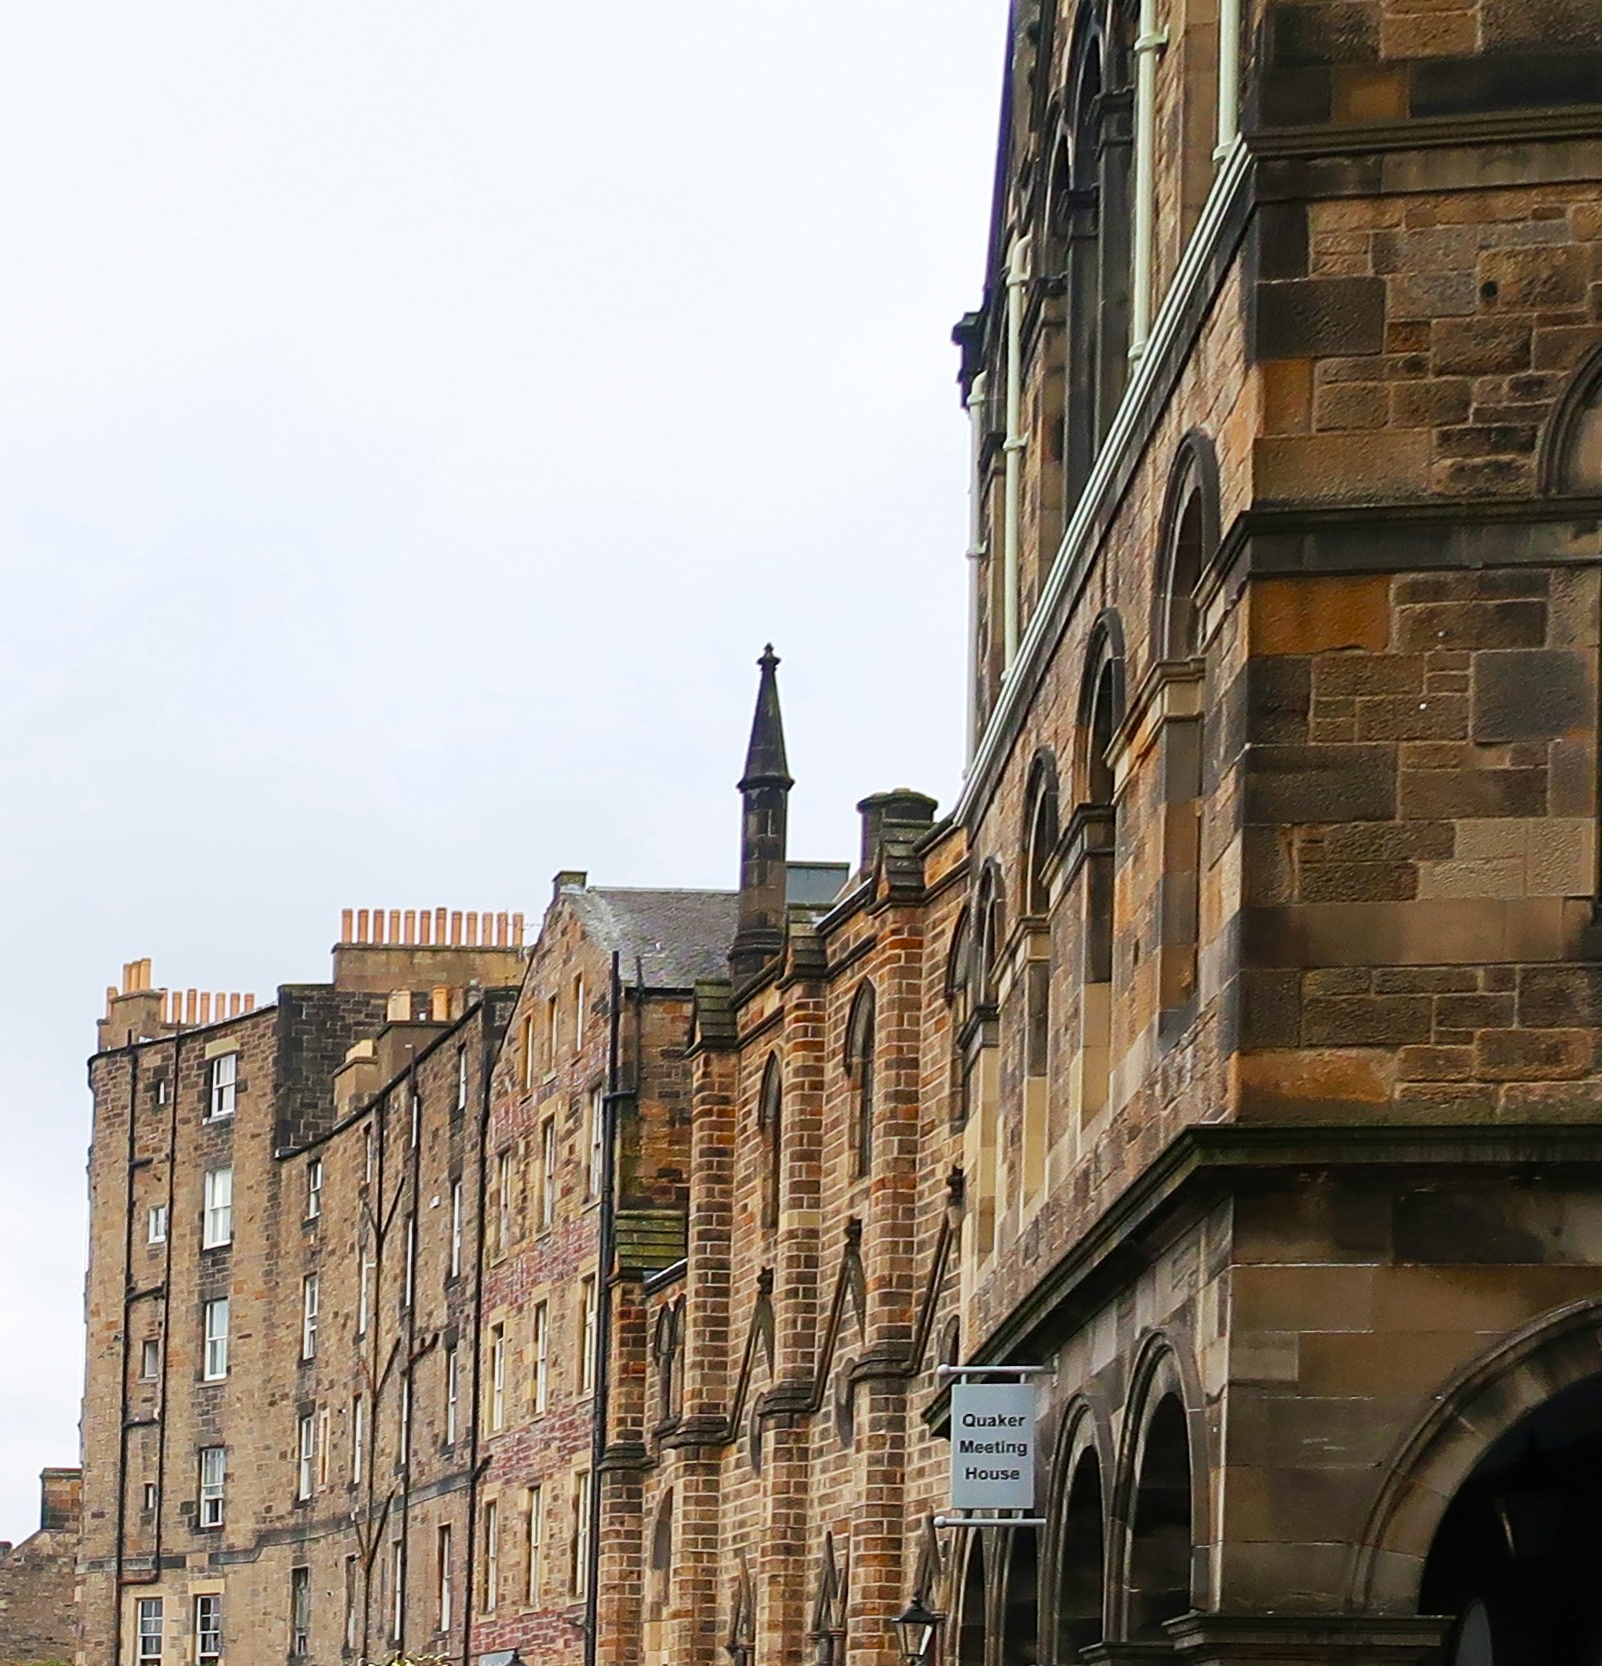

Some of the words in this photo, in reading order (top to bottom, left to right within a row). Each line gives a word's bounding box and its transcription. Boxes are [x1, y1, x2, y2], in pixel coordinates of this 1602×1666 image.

[962, 1413, 1026, 1428] Quaker
[959, 1440, 1028, 1457] Meeting
[965, 1467, 1020, 1480] House
